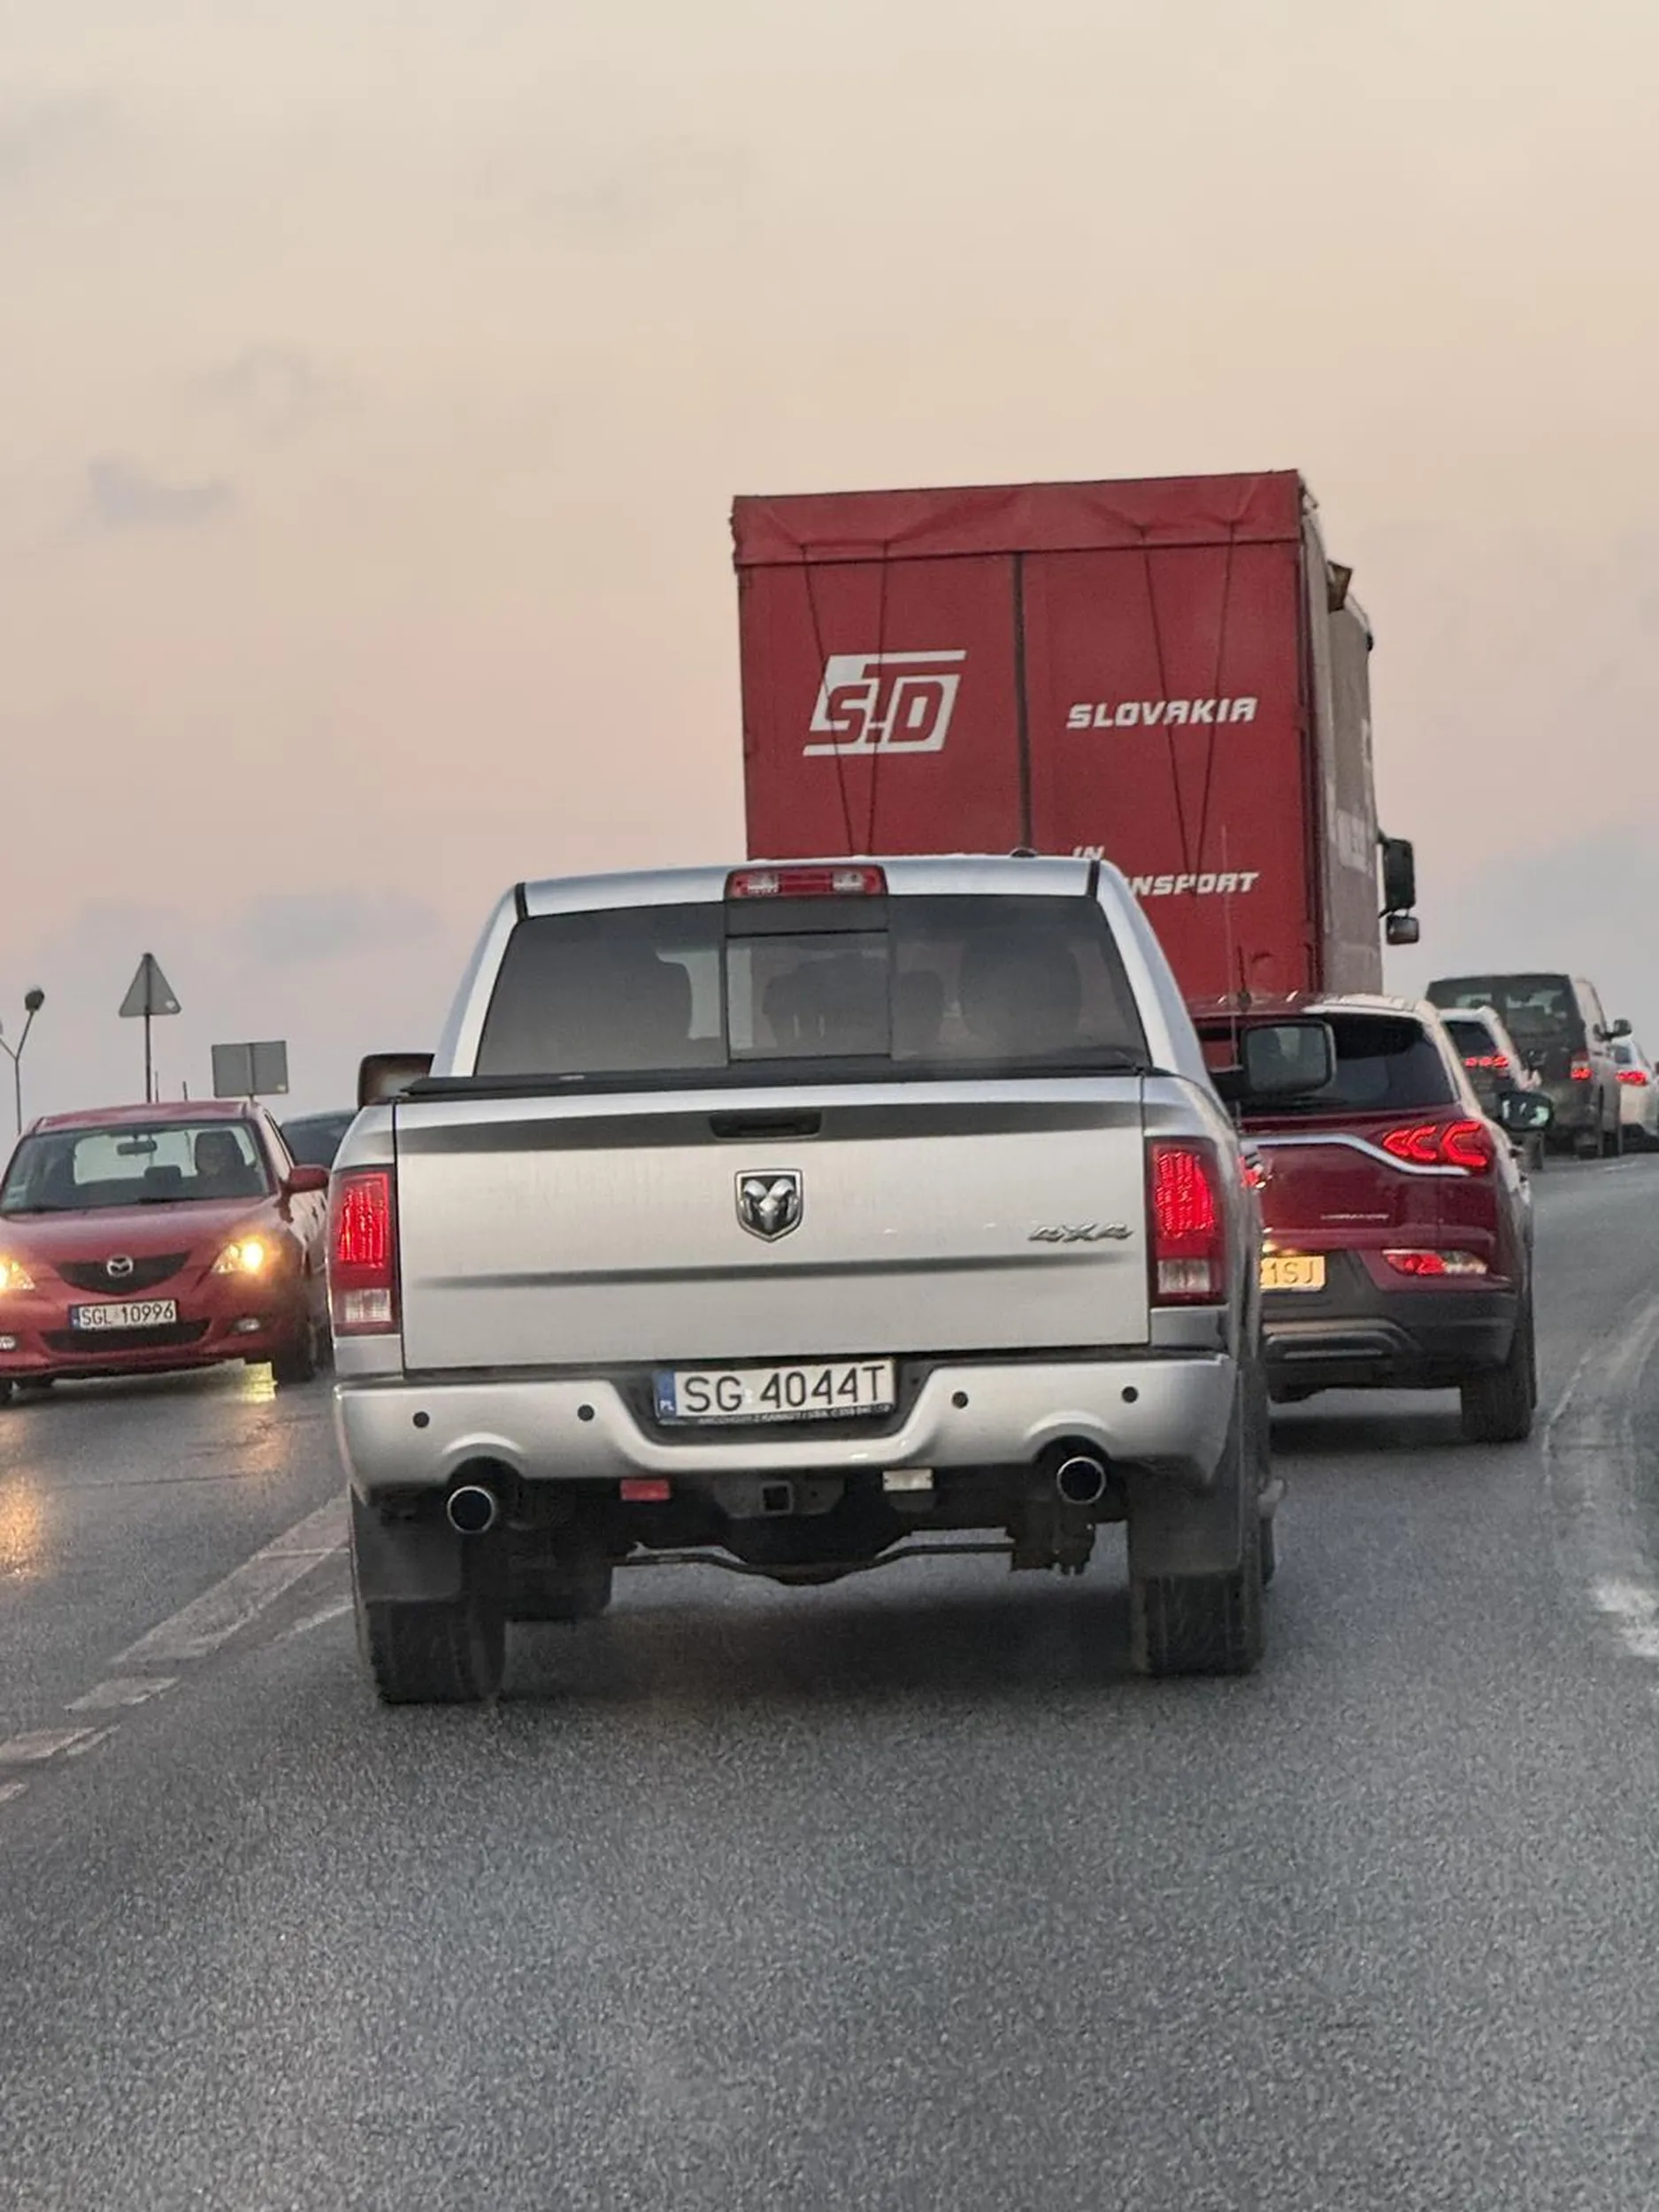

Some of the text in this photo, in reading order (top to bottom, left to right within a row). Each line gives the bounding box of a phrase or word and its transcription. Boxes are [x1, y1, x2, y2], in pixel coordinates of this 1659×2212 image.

[1066, 697, 1257, 729] SLOVAKIA
[1125, 872, 1259, 896] NSPORT
[1261, 1260, 1314, 1285] 1SJ
[81, 1308, 112, 1326] SGL
[121, 1302, 173, 1325] 10996
[684, 1365, 886, 1413] SG 4044T
